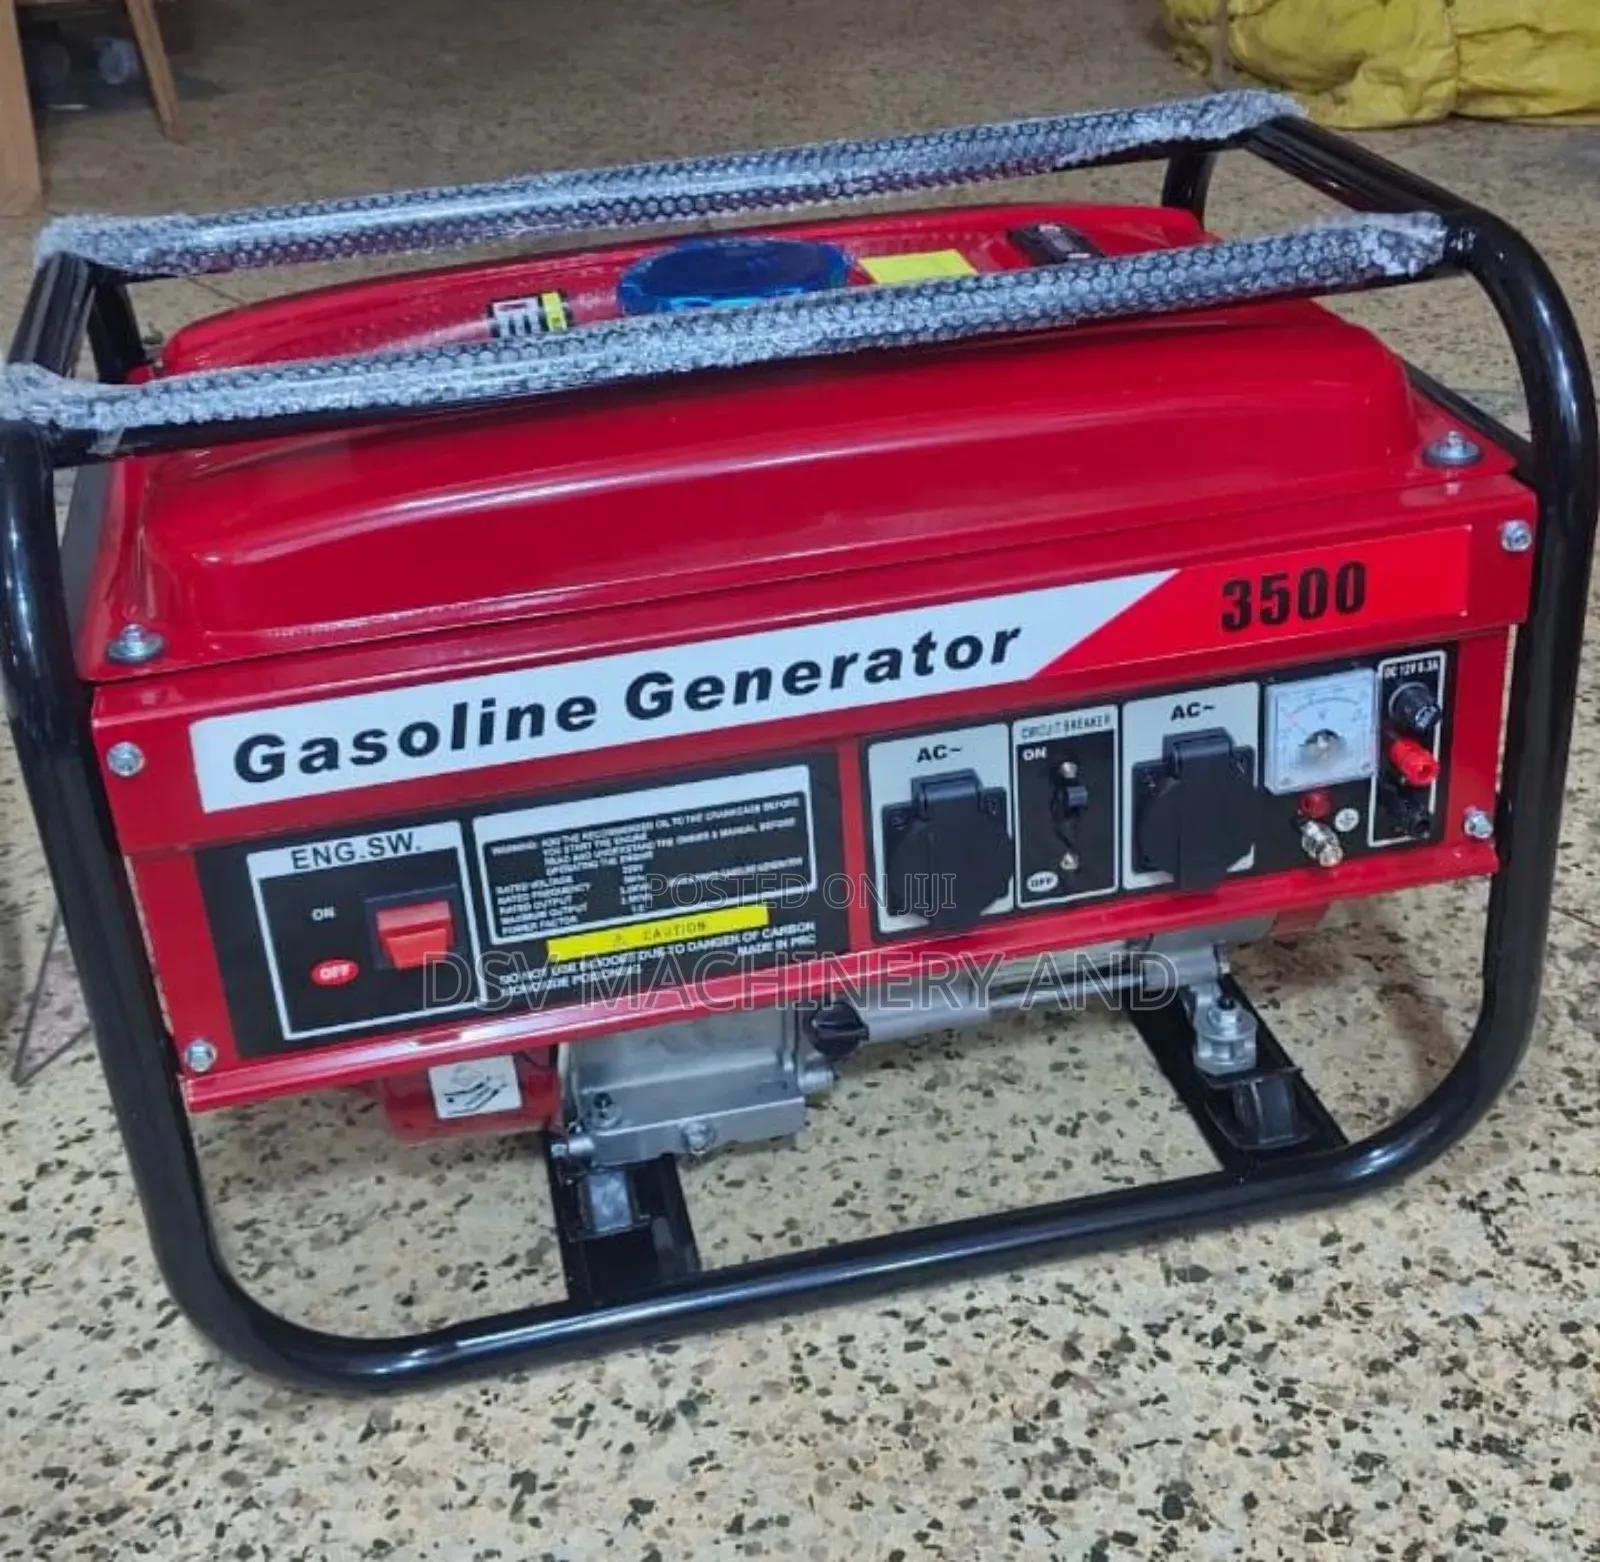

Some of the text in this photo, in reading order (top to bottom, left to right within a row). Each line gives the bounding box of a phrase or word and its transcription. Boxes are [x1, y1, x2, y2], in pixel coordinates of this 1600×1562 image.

[1221, 560, 1367, 632] 3500
[234, 624, 1021, 783] Gasoline Generator
[1064, 712, 1111, 732] BREAKER
[1022, 746, 1047, 761] ON
[291, 831, 421, 870] ENG.SW.
[1029, 876, 1054, 889] OFF
[311, 906, 336, 921] ON
[642, 921, 706, 941] CAUTION
[742, 930, 759, 942] OF
[762, 921, 815, 939] CARBON
[736, 933, 816, 956] MADE IN PRC
[319, 963, 350, 980] OFF
